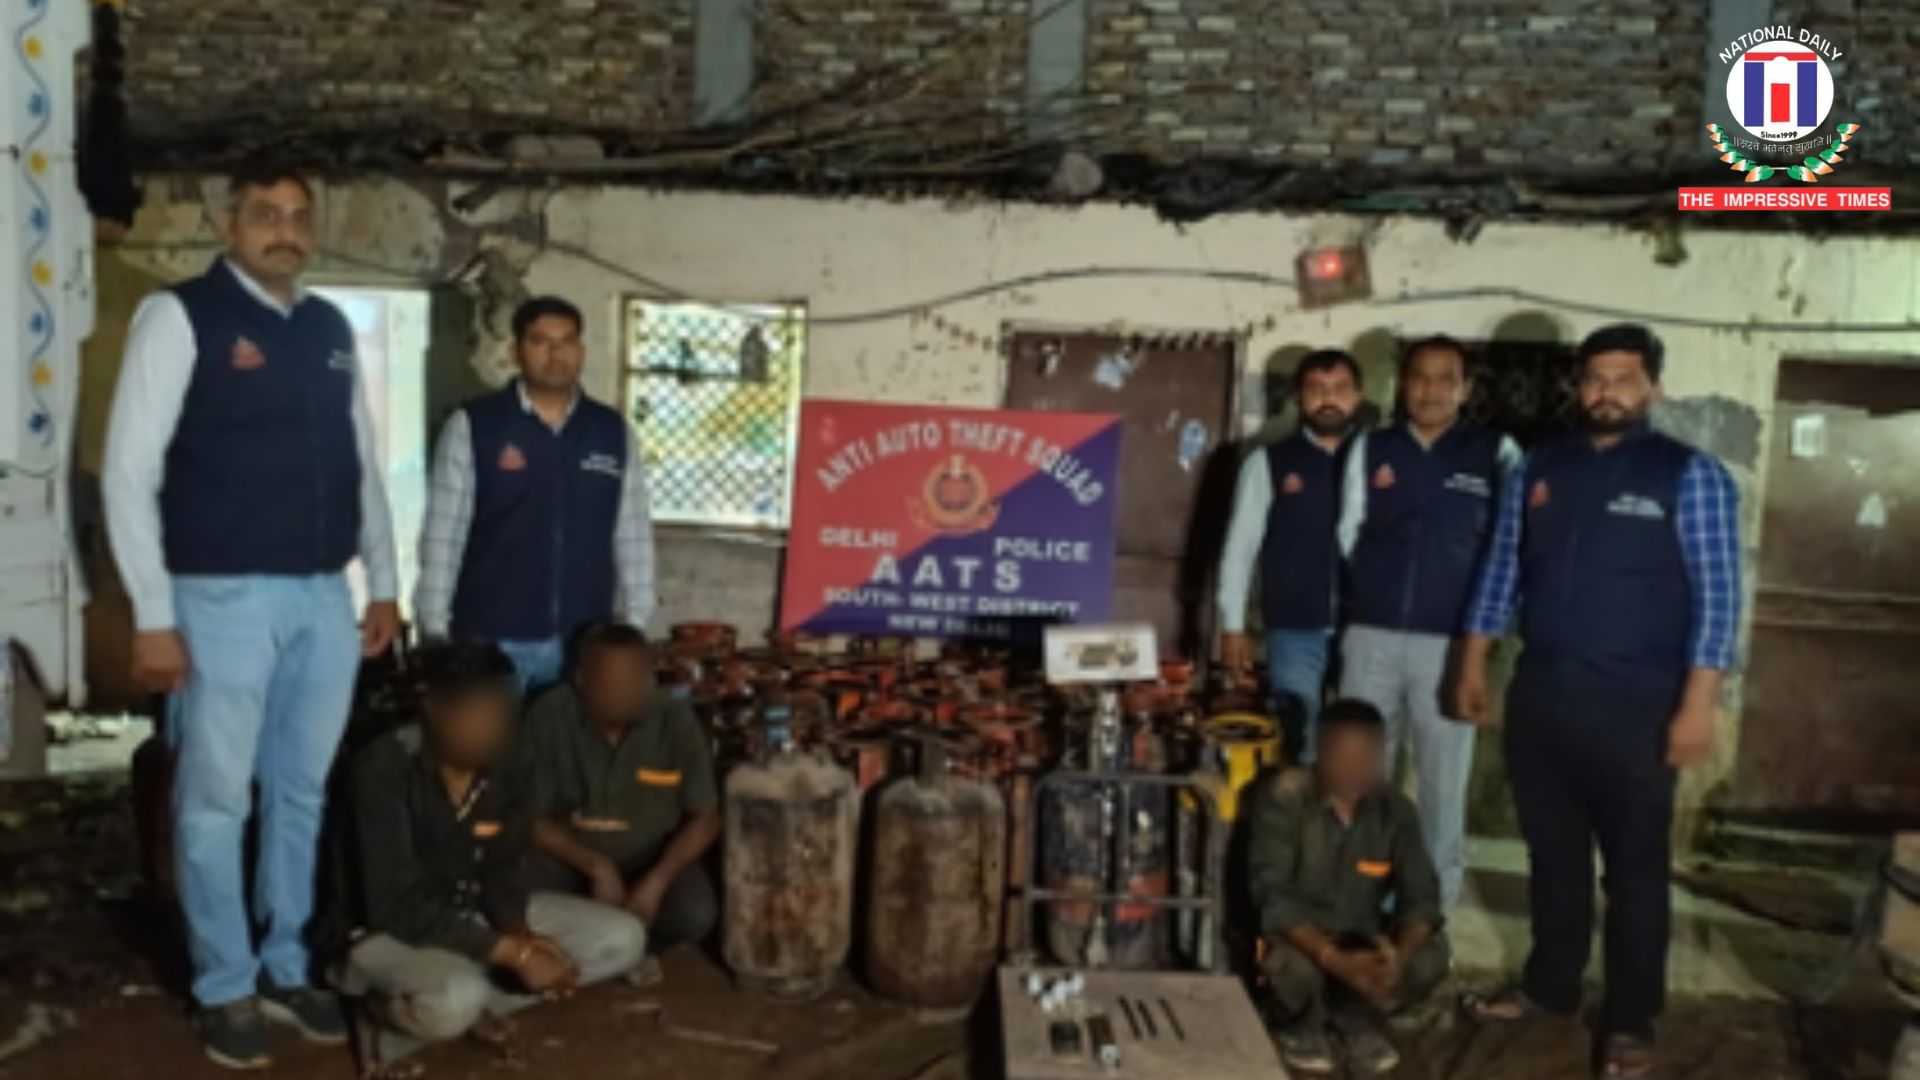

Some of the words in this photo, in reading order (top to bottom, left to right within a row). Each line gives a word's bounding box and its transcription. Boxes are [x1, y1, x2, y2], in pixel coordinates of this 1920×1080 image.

[816, 437, 874, 491] ANTI
[876, 419, 941, 457] AUTO
[949, 418, 1025, 456] THEFT
[1025, 436, 1103, 505] SQUAD
[819, 527, 898, 548] DELHI
[995, 537, 1091, 562] POLICE
[909, 592, 970, 611] WEST
[977, 597, 1080, 617] DISTRICT
[888, 613, 939, 630] NEW
